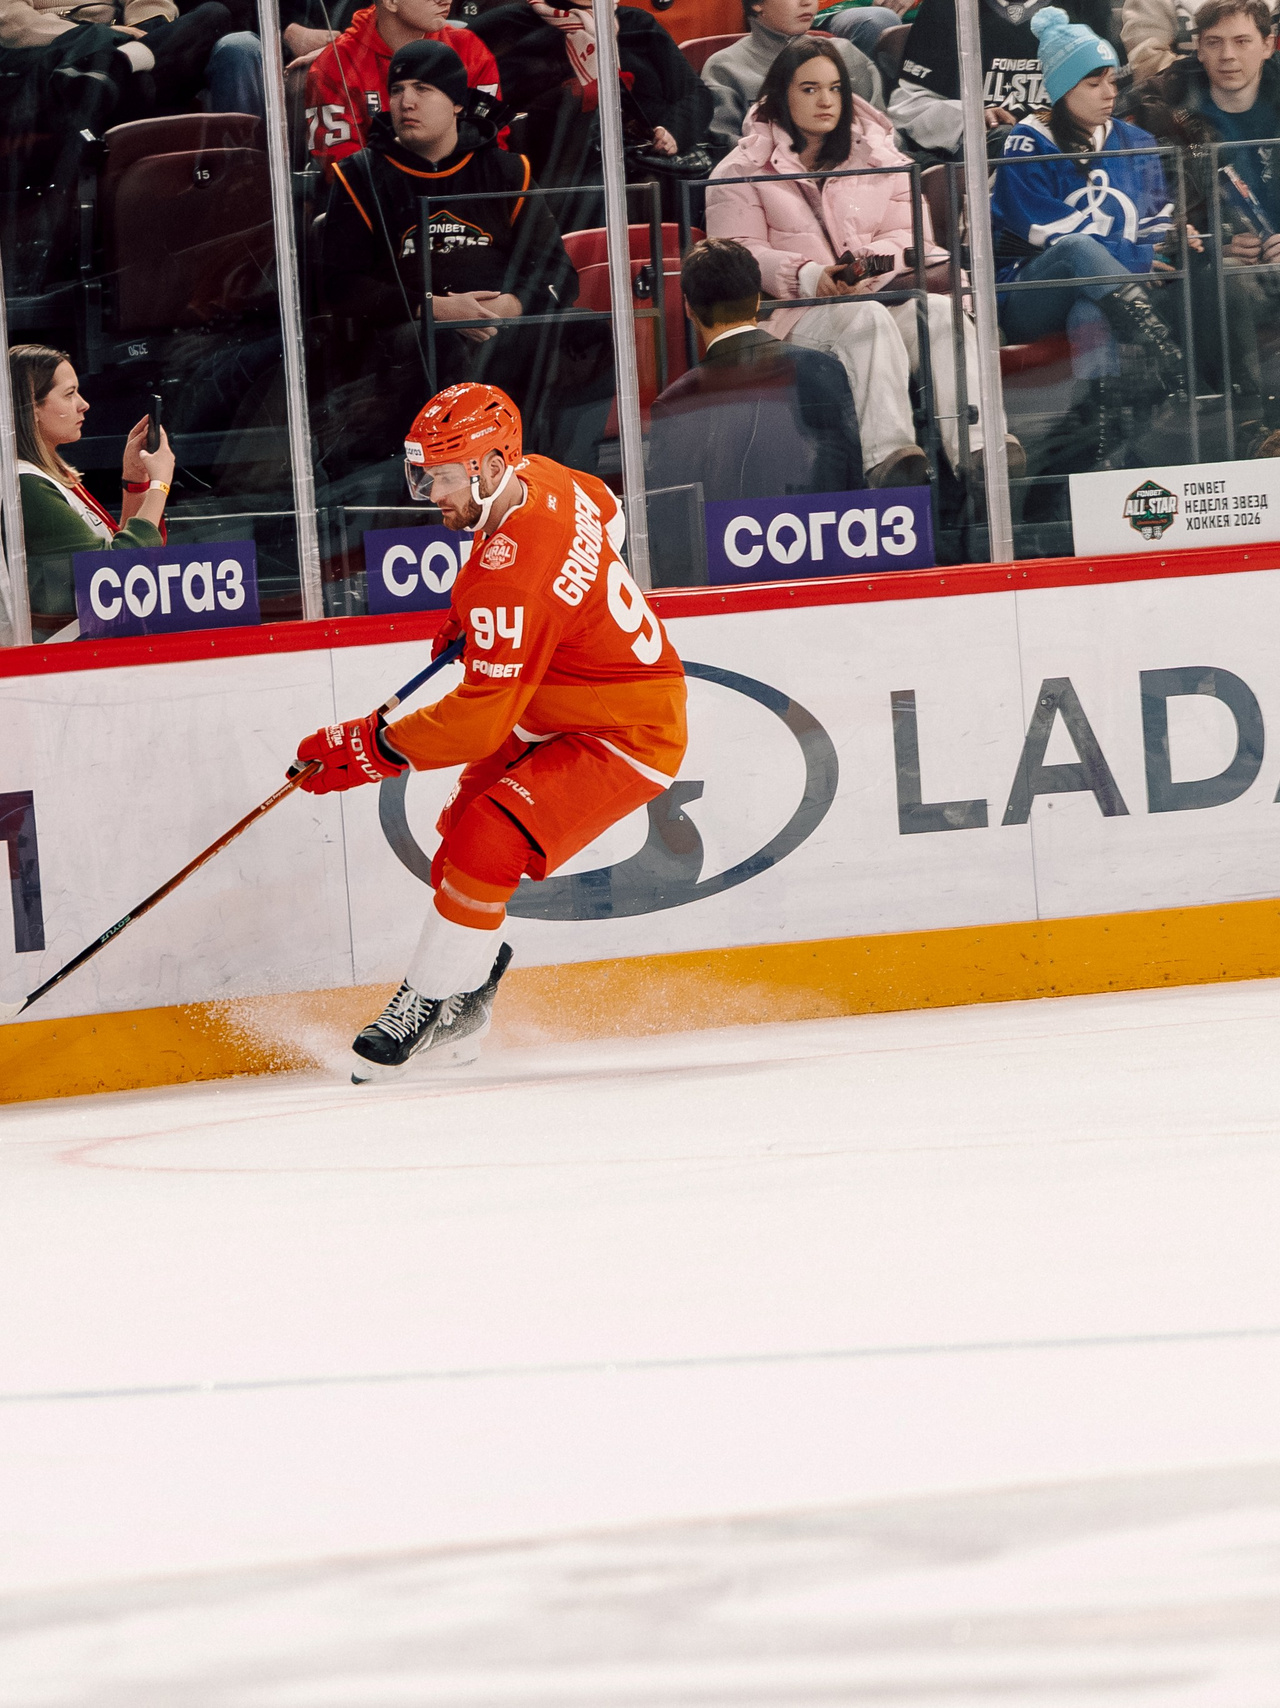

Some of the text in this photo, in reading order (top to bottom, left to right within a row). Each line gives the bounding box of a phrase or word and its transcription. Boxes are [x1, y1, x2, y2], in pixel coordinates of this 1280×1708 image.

[463, 5, 478, 15] 13
[304, 104, 352, 151] 75
[196, 169, 210, 180] 15
[428, 223, 467, 234] ONBET
[1183, 481, 1226, 496] FONBET
[1184, 494, 1268, 514] НЕДЕЛЯ ЗВЕЗД
[1185, 512, 1261, 531] ХОККЕЯ 2026
[469, 605, 525, 650] 94
[349, 725, 384, 780] SOYUZ
[890, 665, 1280, 835] LAD
[100, 914, 131, 944] SOYUZ
